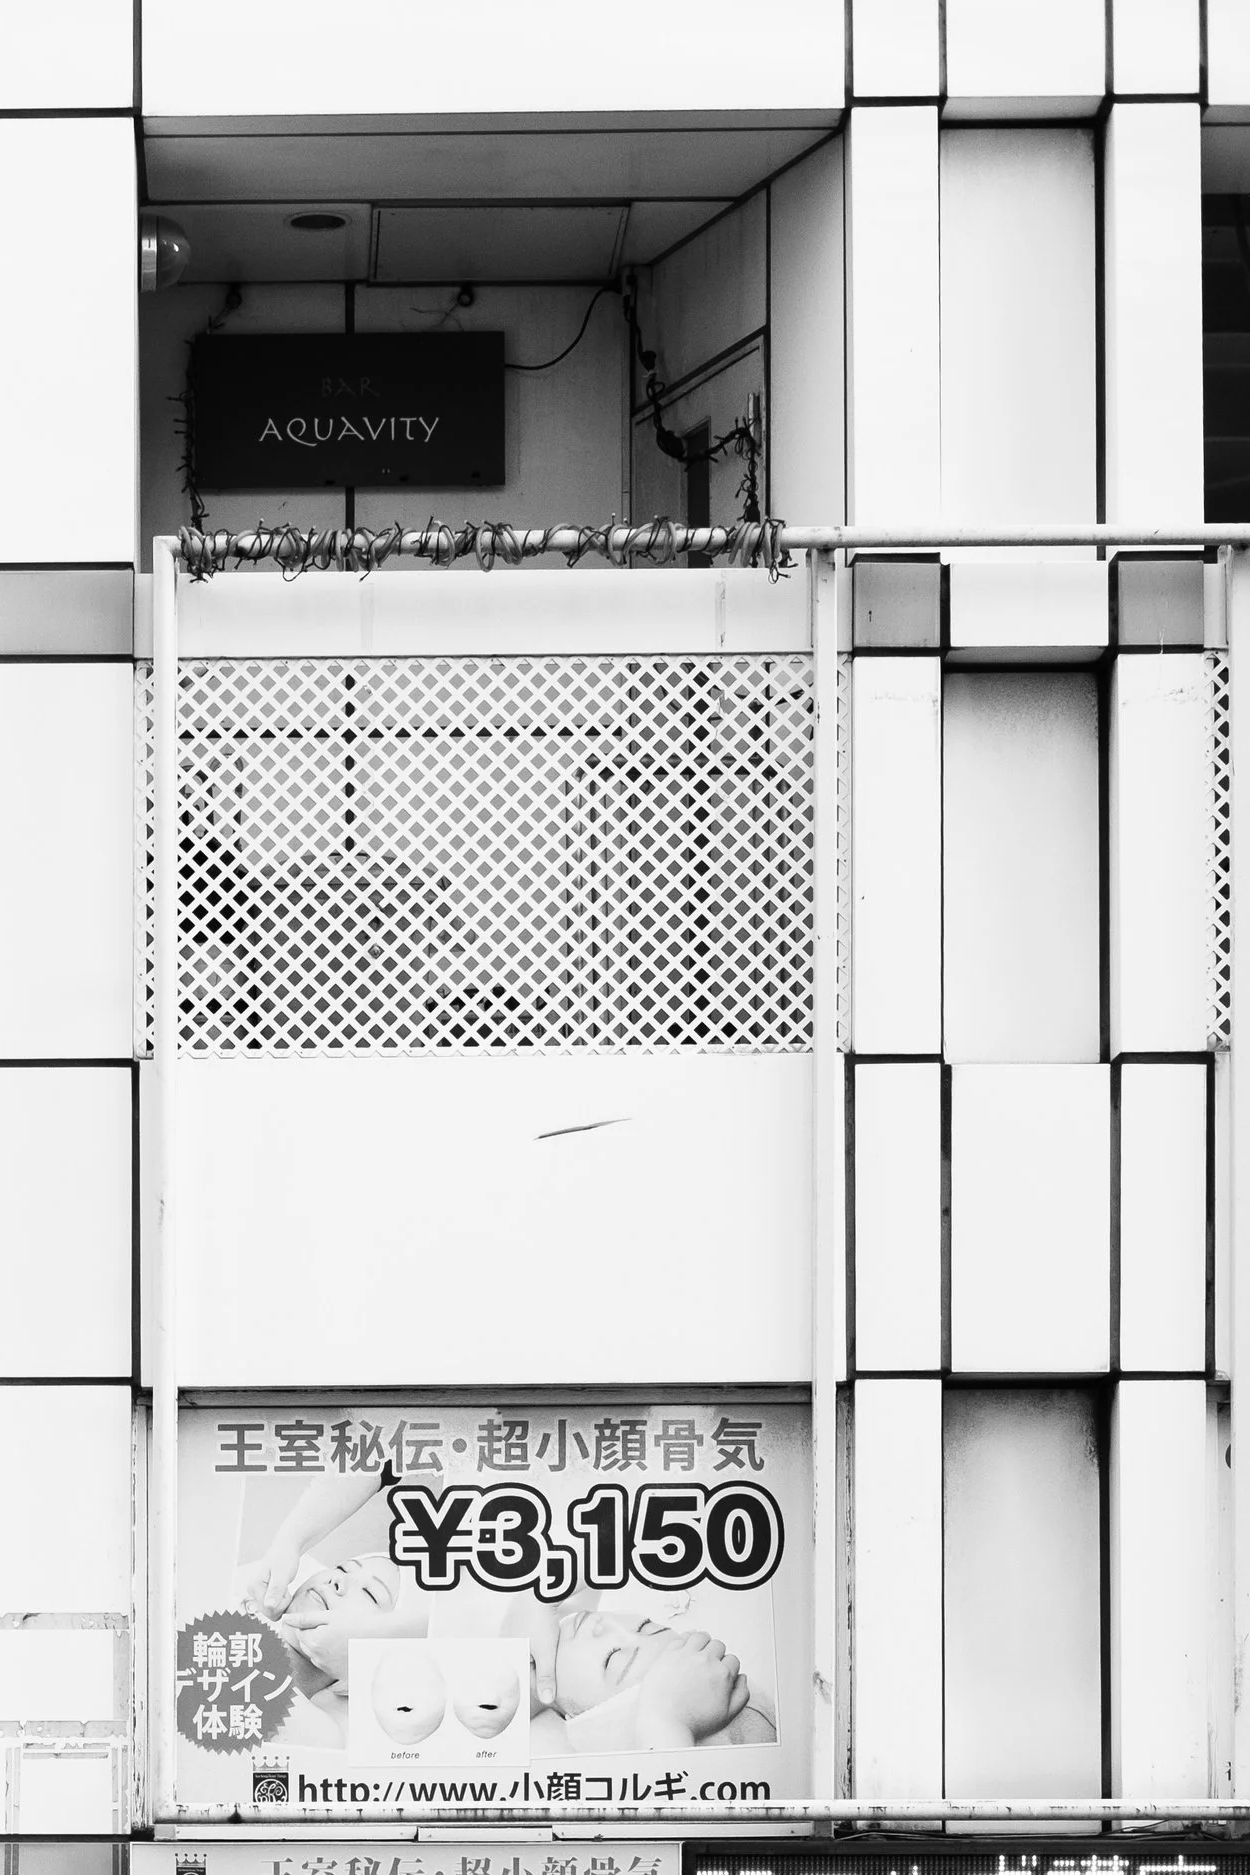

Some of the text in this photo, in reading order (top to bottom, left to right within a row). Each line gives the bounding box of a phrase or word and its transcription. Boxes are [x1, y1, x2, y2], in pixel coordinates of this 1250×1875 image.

[321, 376, 381, 398] BAR
[258, 416, 440, 447] AQUAVITY
[214, 1416, 766, 1474] 王室秘伝・超小顔骨気
[389, 1481, 785, 1603] ¥3,150
[192, 1631, 263, 1668] 輪郭
[177, 1666, 293, 1703] デザイン
[192, 1703, 263, 1740] 体験
[390, 1750, 420, 1760] before
[475, 1749, 497, 1759] after
